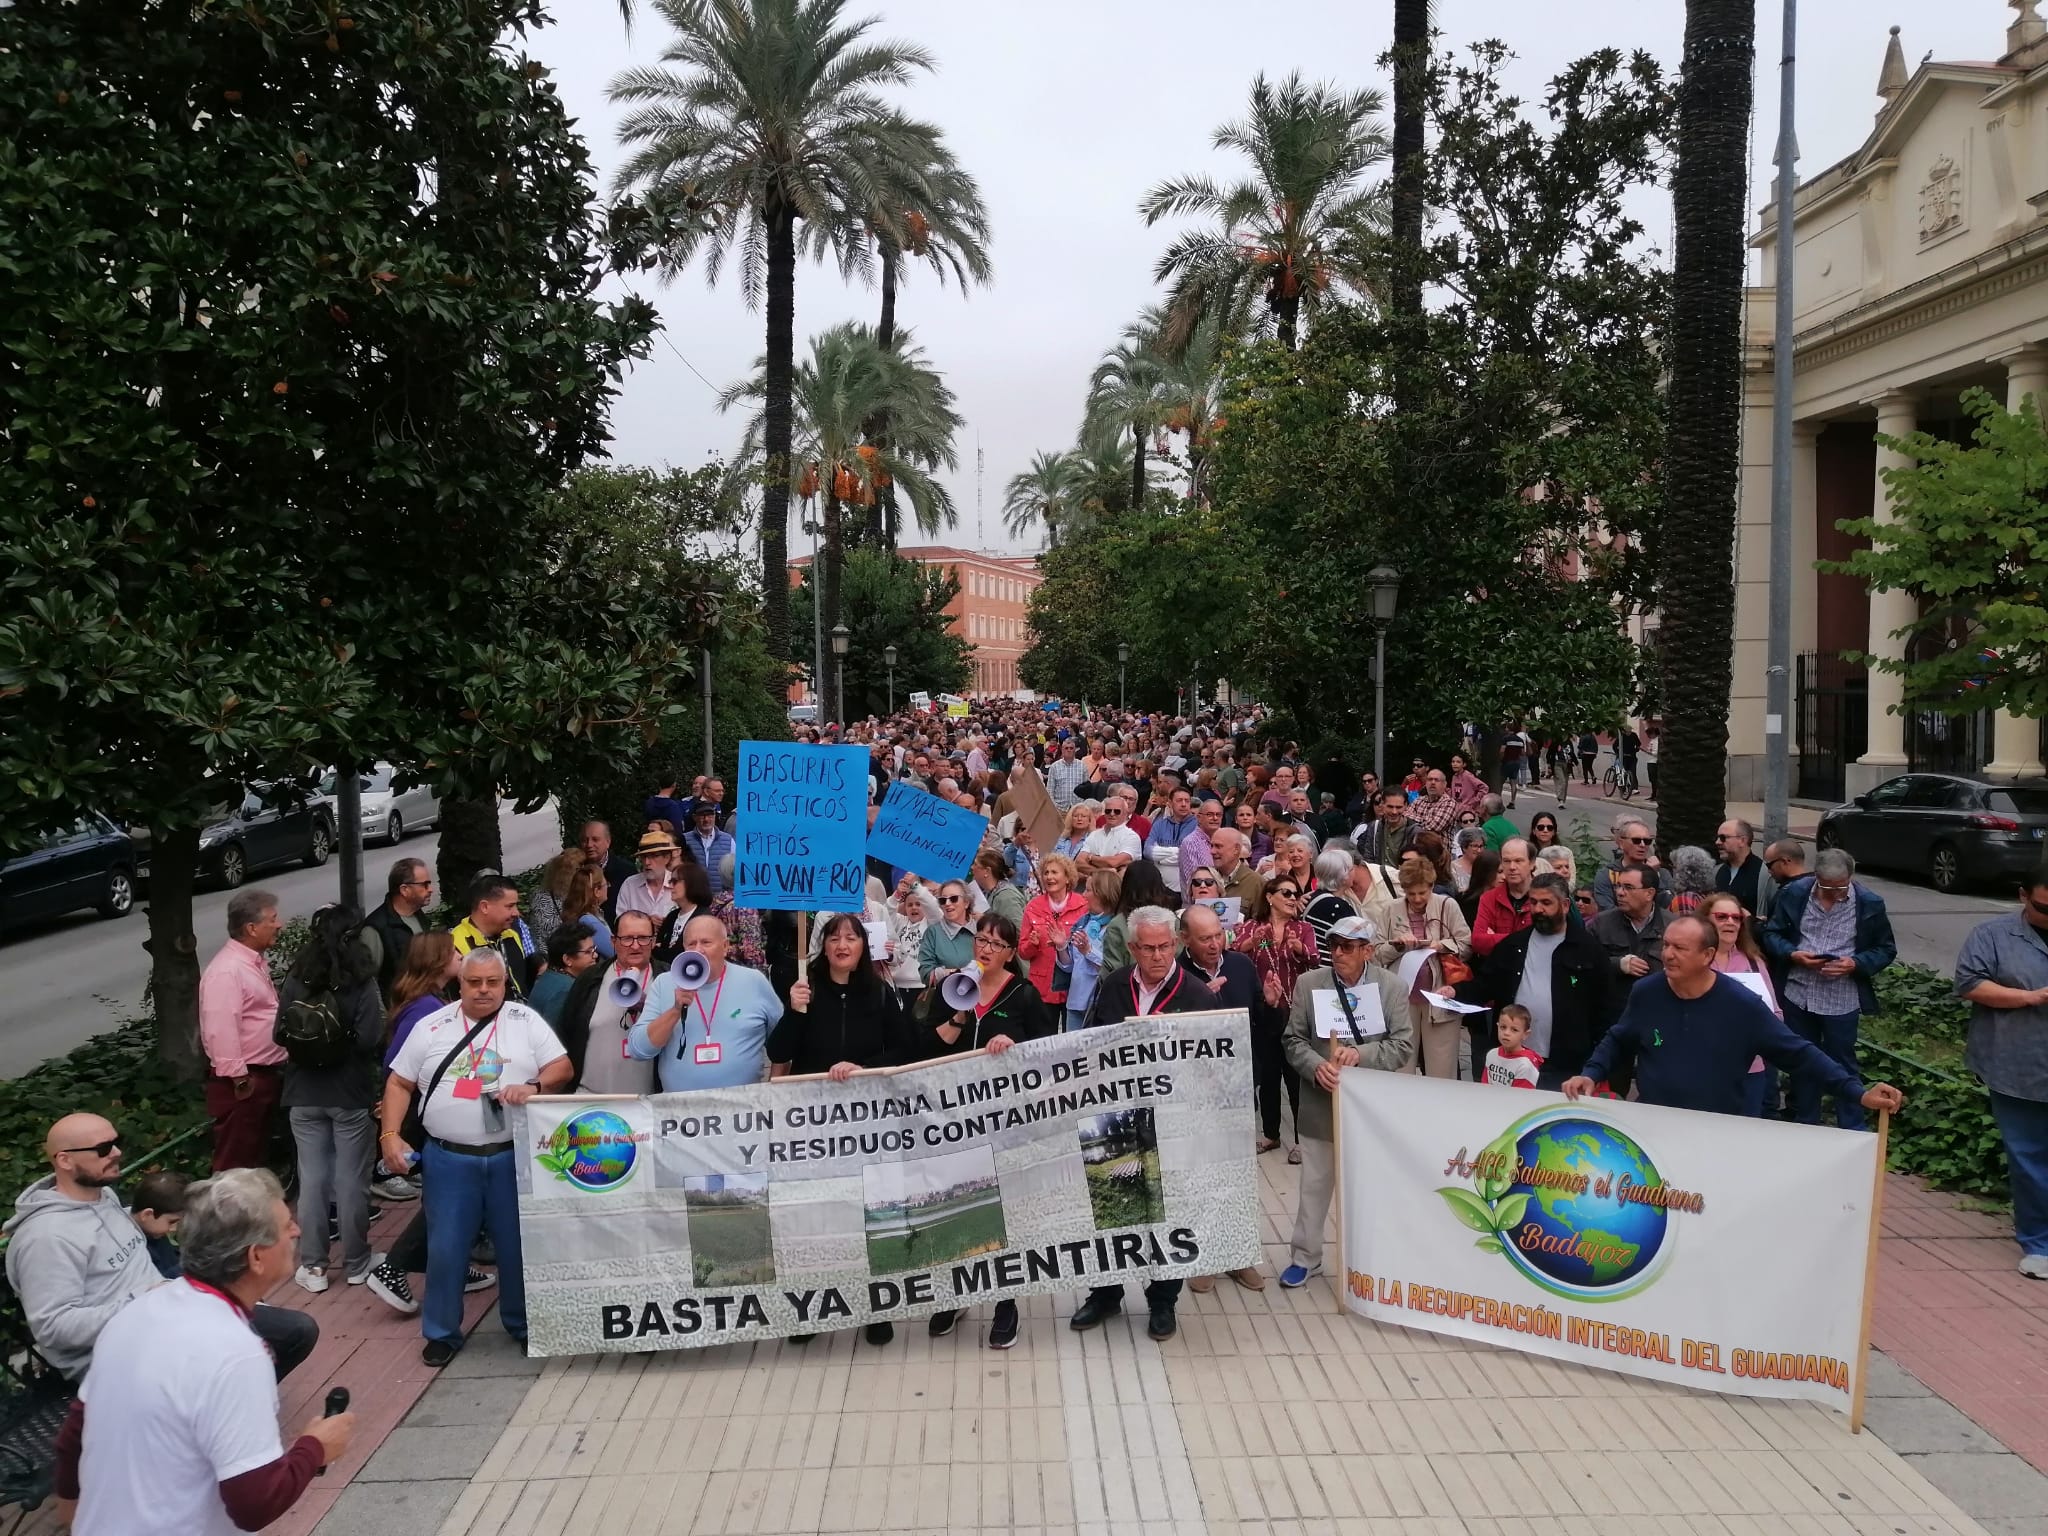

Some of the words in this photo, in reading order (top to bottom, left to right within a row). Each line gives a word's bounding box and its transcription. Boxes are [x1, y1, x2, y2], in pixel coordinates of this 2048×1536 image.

[748, 754, 845, 791] BASURAS
[747, 788, 847, 821] PLÁSTICOS
[740, 861, 771, 886] NO
[775, 864, 815, 895] VAN
[829, 859, 862, 895] RÍO
[661, 1115, 723, 1138] POR
[733, 1110, 774, 1134] UN
[939, 1069, 1042, 1110] LIMPIO
[1052, 1057, 1090, 1084] DE
[1098, 1036, 1236, 1072] NENÚFAR
[739, 1143, 759, 1166] Y
[769, 1127, 915, 1164] RESIDUOS
[924, 1075, 1174, 1141] CONTAMINANTES
[1508, 1155, 1590, 1194] Salvemos
[1594, 1170, 1611, 1199] el
[1616, 1172, 1706, 1215] Guadiana
[1519, 1222, 1633, 1267] Badajoz
[602, 1294, 771, 1340] BASTA
[783, 1287, 852, 1322] YA
[868, 1273, 935, 1312] DE
[1378, 1278, 1403, 1308] LA
[1408, 1283, 1562, 1341] RECUPERACIÓN
[1567, 1315, 1676, 1365] INTEGRAL
[1681, 1338, 1727, 1374] DEL
[1731, 1348, 1850, 1394] GUADIANA
